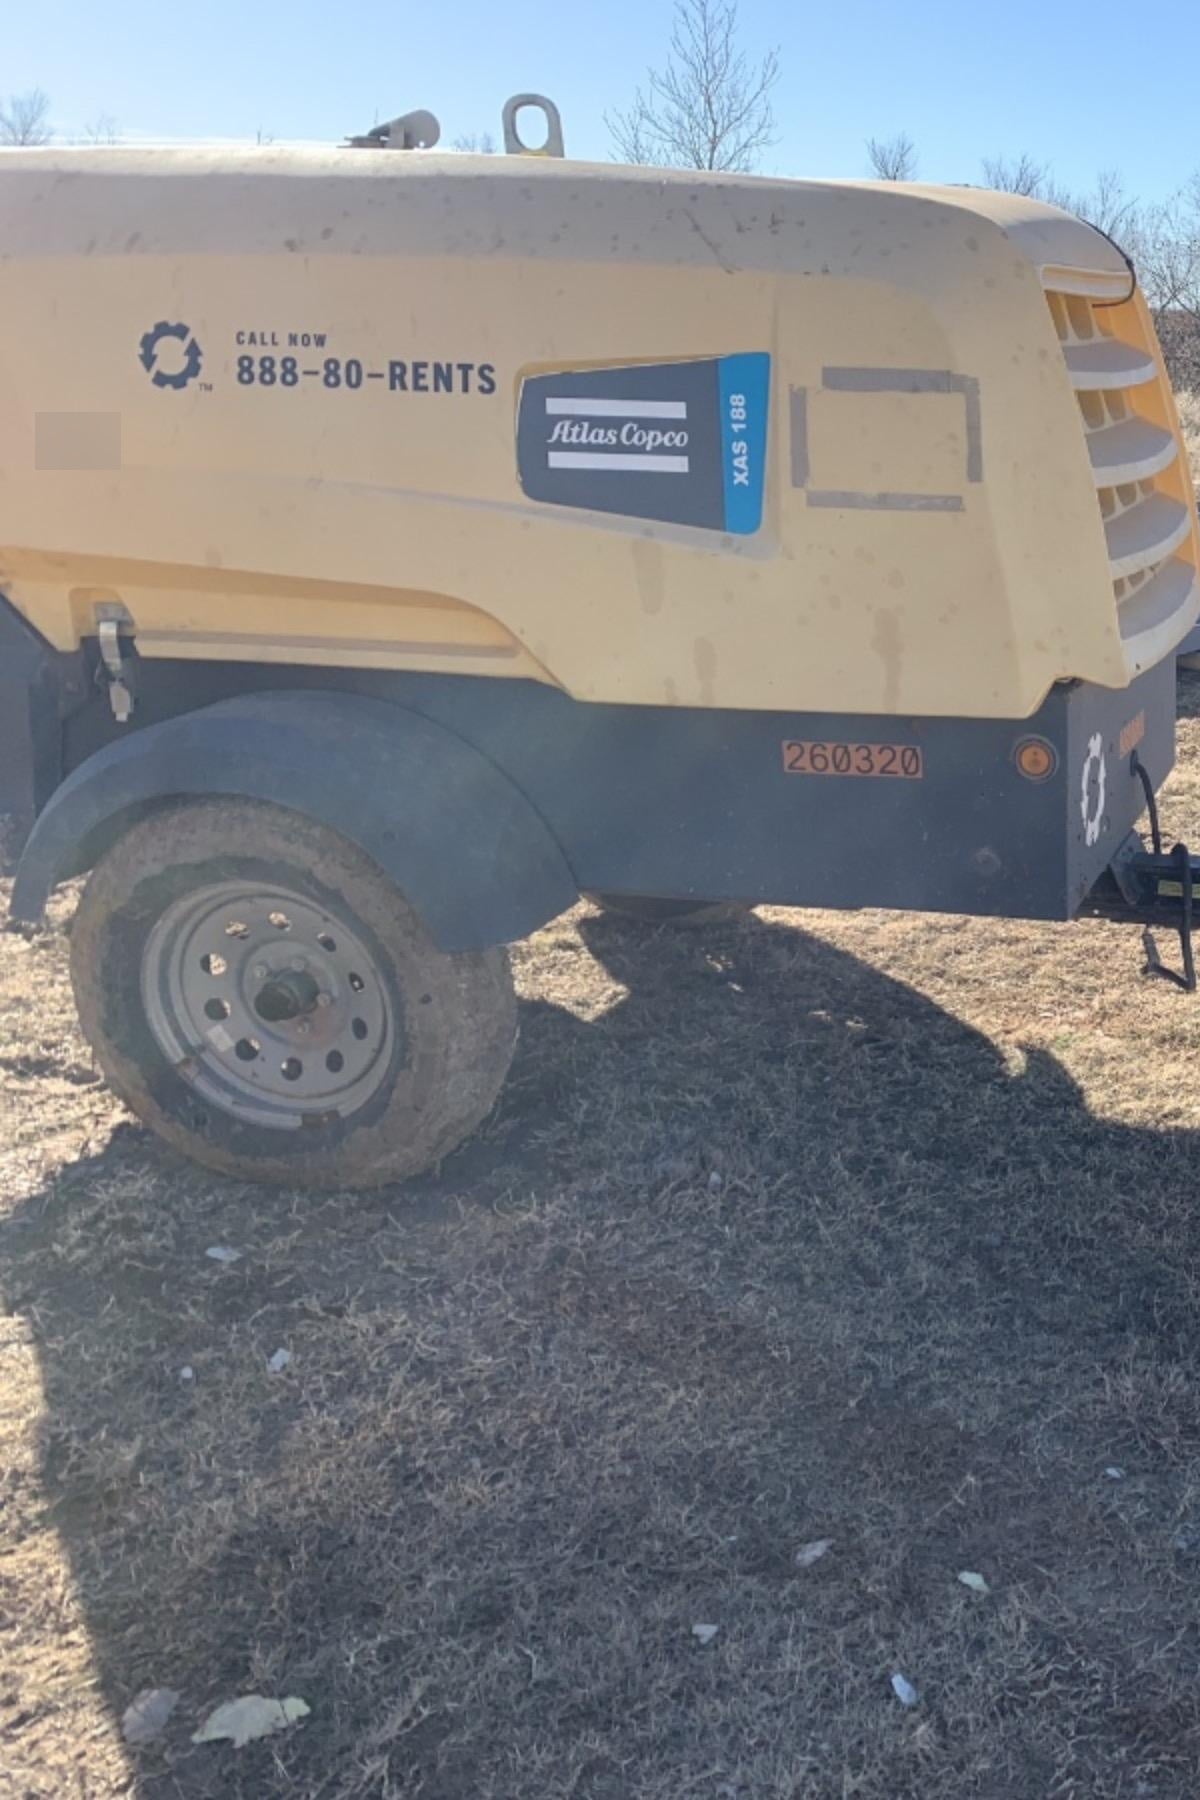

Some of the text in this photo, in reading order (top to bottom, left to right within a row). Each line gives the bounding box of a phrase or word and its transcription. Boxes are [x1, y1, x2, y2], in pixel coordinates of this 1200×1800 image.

[236, 331, 327, 349] CALL NOW
[236, 355, 496, 394] 888-80-RENTS
[547, 420, 689, 451] Atlas Copco
[729, 393, 749, 486] XAS 188
[786, 742, 919, 776] 260320
